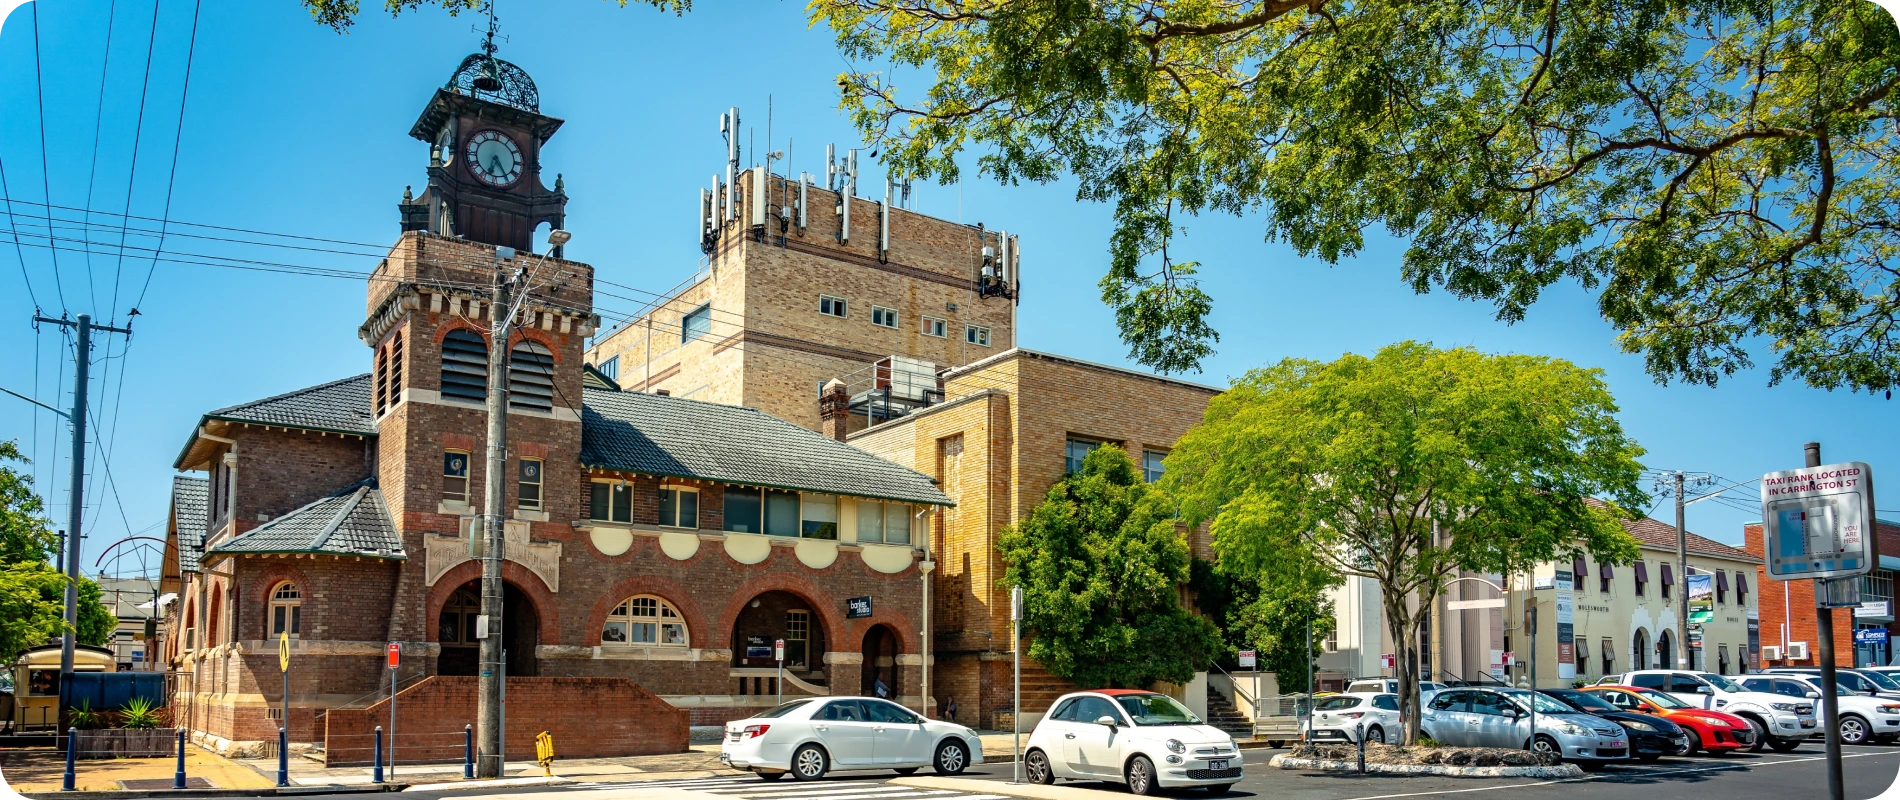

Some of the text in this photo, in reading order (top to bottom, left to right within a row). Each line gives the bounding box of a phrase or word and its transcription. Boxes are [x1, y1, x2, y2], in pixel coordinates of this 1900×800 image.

[1765, 468, 1860, 486] TAXI RANK LOCATED
[1769, 488, 1778, 496] IN
[1781, 480, 1843, 494] CARRINGTON
